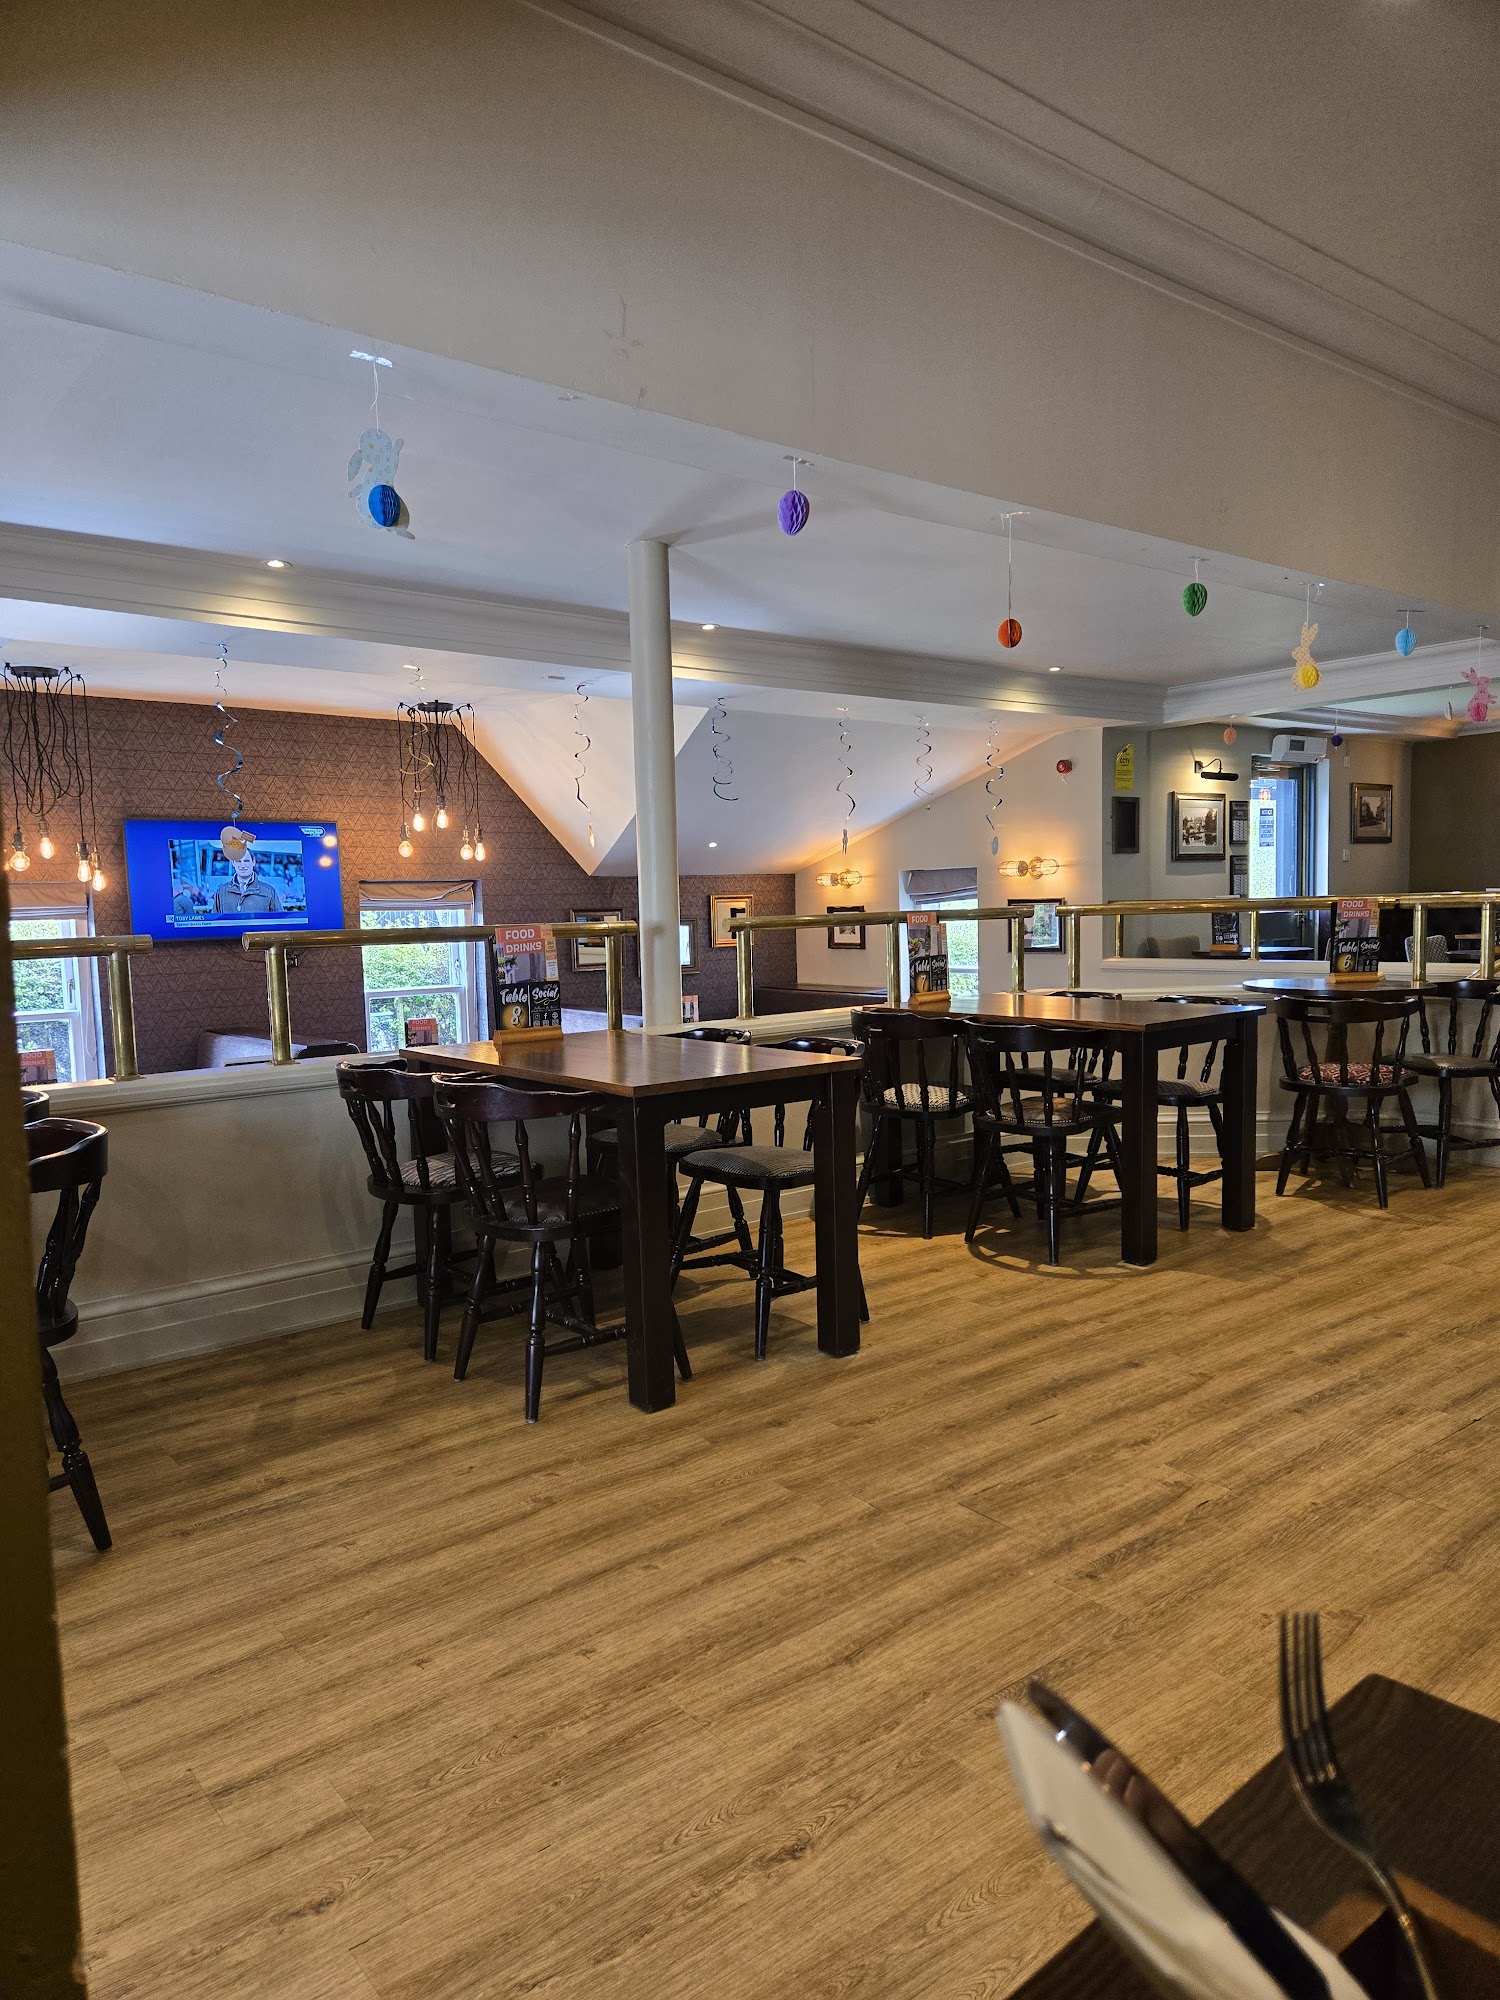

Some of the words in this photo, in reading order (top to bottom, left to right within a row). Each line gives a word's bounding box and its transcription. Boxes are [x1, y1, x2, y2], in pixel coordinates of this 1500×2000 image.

[911, 915, 929, 923] FOOD
[505, 929, 535, 940] FOOD
[506, 942, 542, 953] DRINKS
[1338, 941, 1358, 953] Table
[1360, 941, 1380, 951] Social
[915, 960, 930, 973] Table
[1344, 954, 1352, 969] 6
[921, 974, 926, 989] 7
[500, 988, 527, 1005] Table
[532, 987, 559, 1001] Social
[511, 1005, 521, 1026] 8
